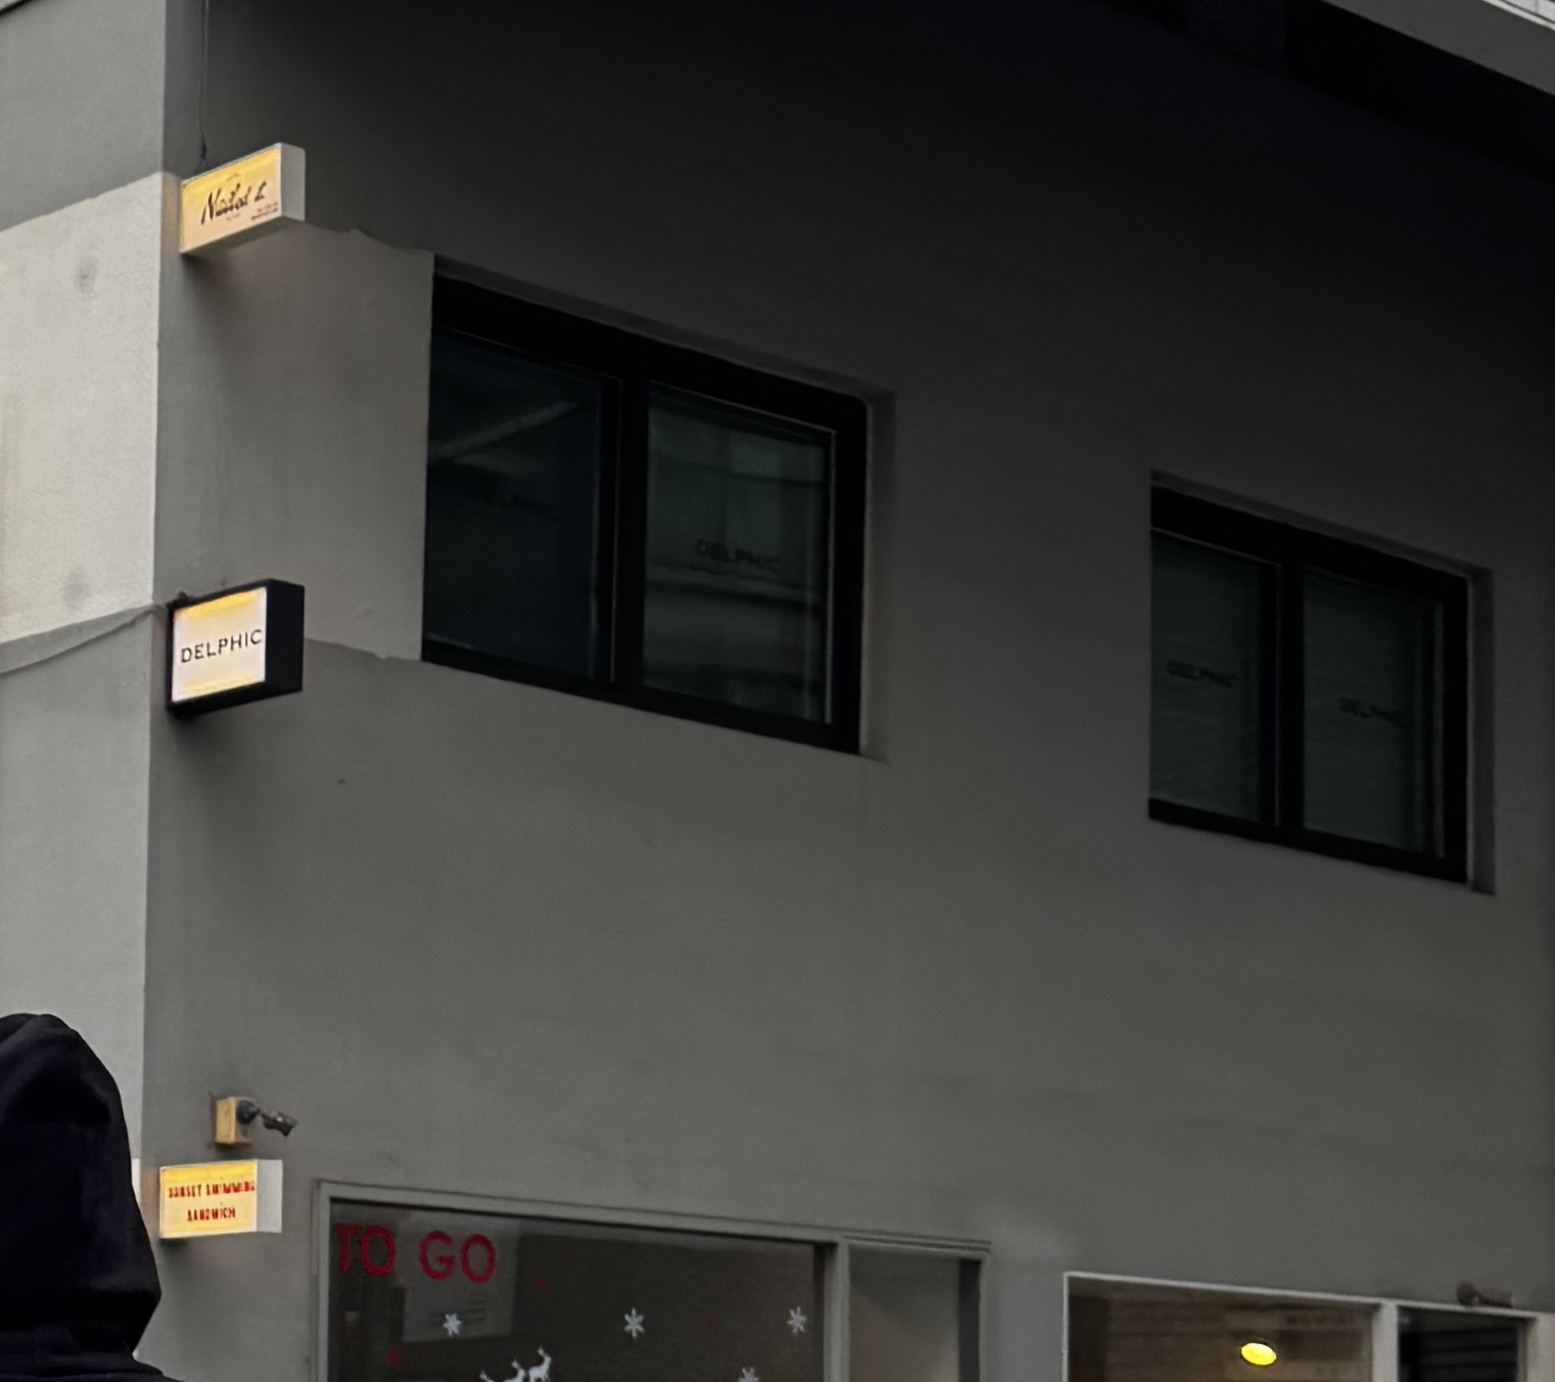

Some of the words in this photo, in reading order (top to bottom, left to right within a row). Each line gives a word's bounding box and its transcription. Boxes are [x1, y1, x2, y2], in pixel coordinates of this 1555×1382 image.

[180, 629, 262, 663] DELPHIC
[187, 1206, 236, 1221] SANDWICH
[333, 1222, 396, 1277] TO
[418, 1230, 496, 1283] GO
